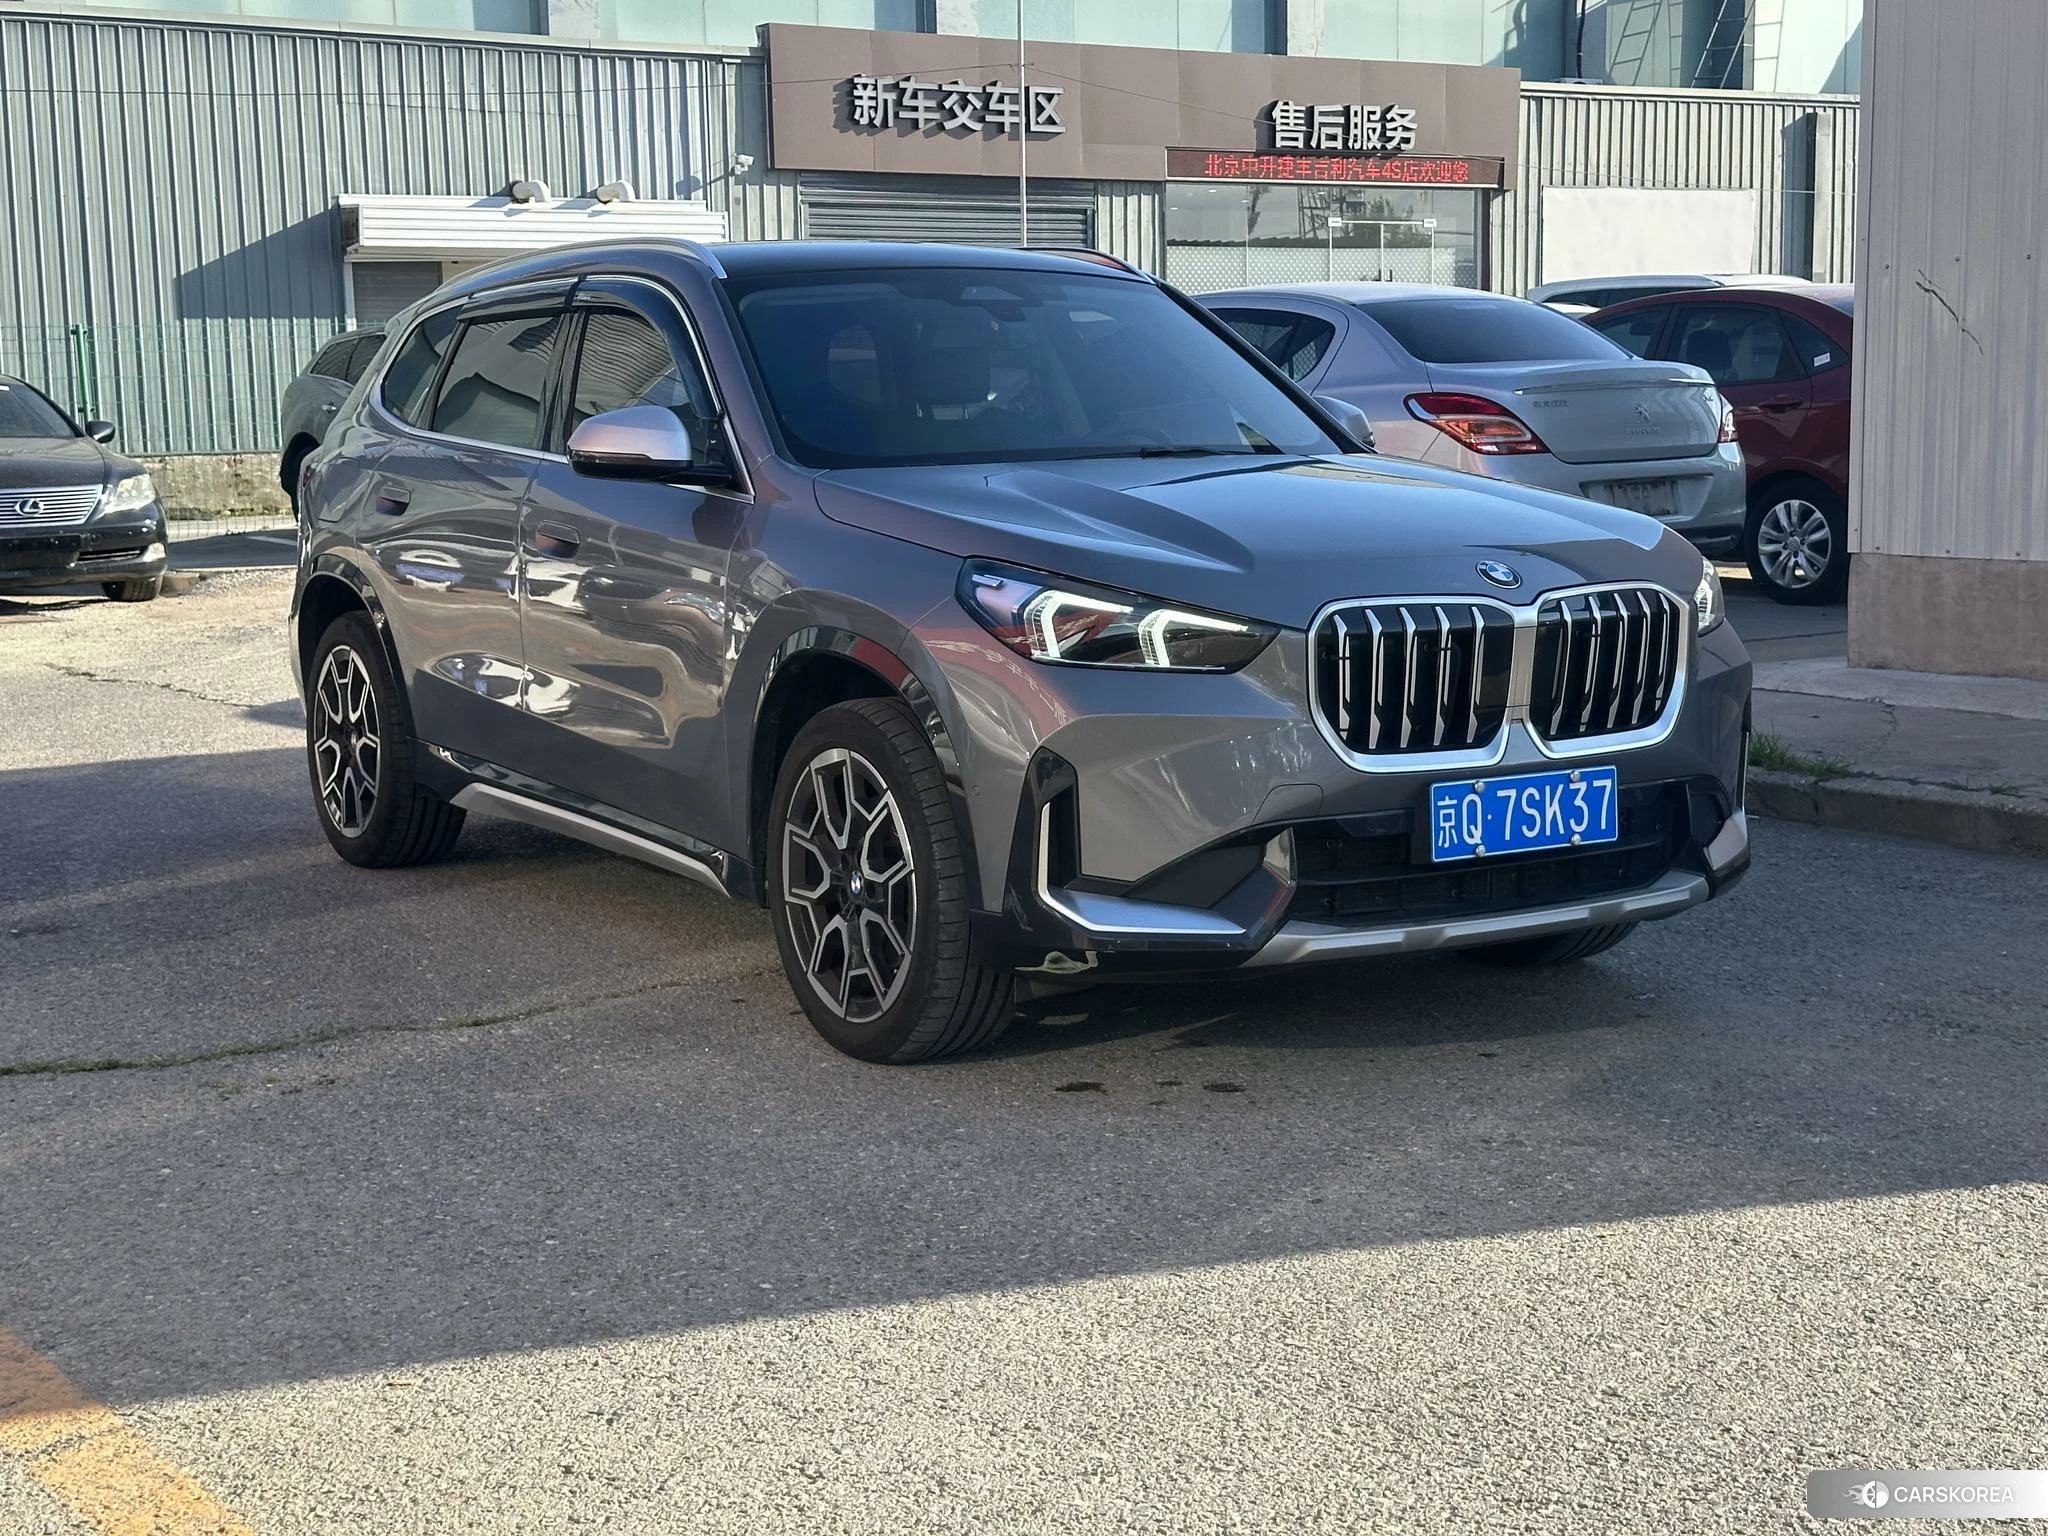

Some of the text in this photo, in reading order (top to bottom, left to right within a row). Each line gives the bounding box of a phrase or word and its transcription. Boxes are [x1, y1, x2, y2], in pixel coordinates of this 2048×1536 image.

[853, 74, 1066, 133] 新车交车区
[1271, 100, 1418, 150] 售后服务
